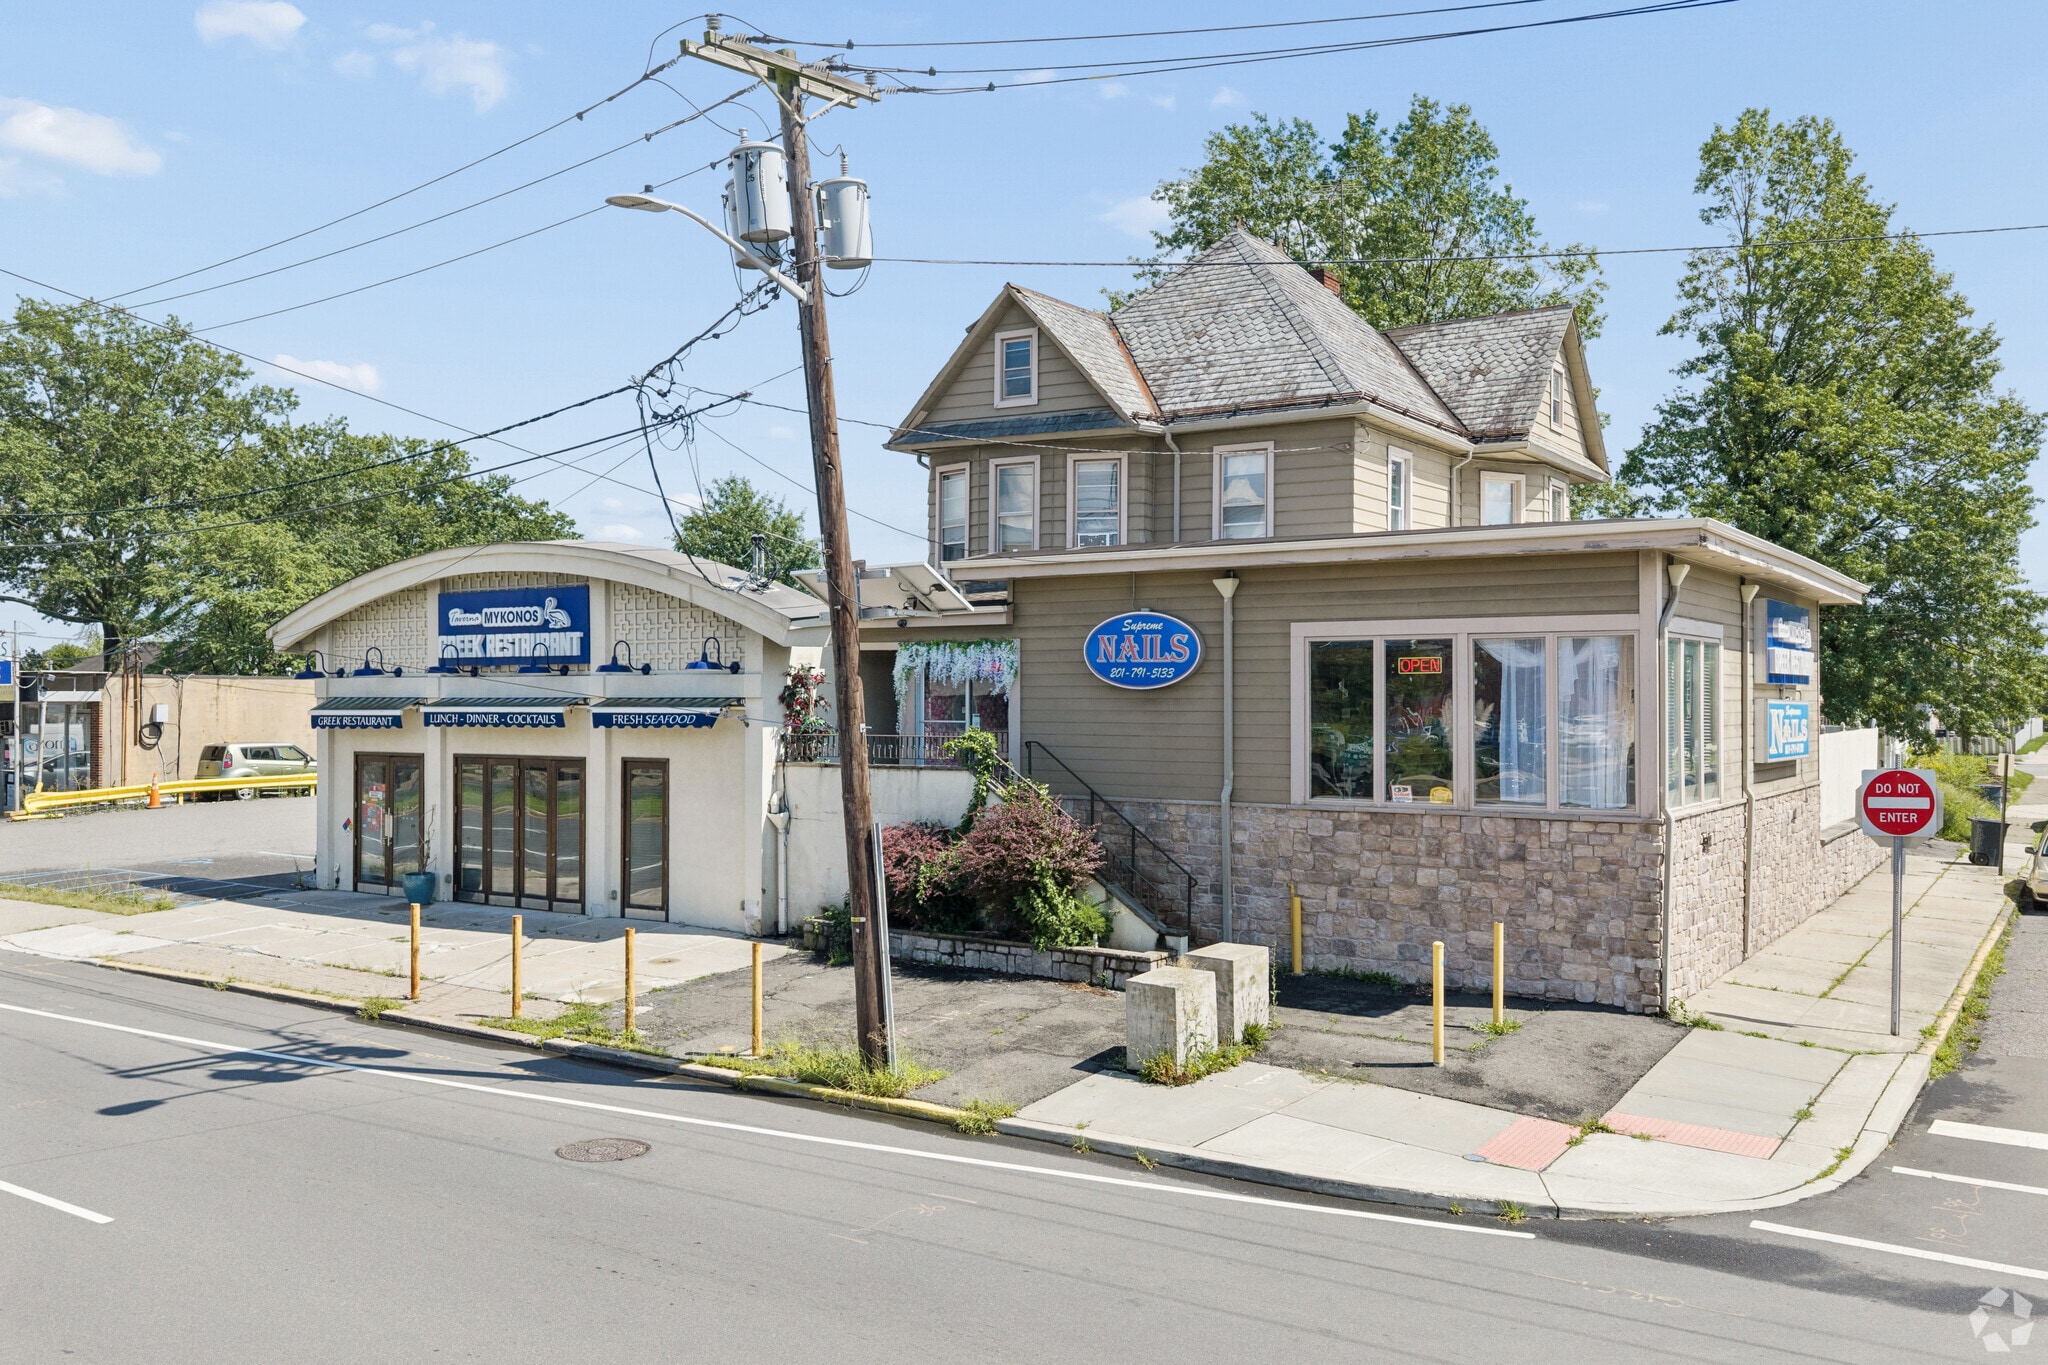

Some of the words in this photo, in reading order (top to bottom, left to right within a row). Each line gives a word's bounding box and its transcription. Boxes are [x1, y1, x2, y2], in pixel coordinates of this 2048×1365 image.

[450, 610, 480, 623] Taverna
[484, 609, 539, 624] MYKONOS
[1122, 619, 1163, 633] Supreme
[486, 632, 583, 657] RESTAURANT
[1096, 633, 1190, 663] NAILS
[1400, 658, 1440, 672] OPEN
[1110, 667, 1175, 678] 201-791-5133
[317, 716, 341, 726] GREEK
[342, 716, 393, 726] RESTAURANT
[429, 714, 458, 724] LUNCH
[466, 714, 500, 724] DINNER
[506, 714, 556, 725] COCKTAILS
[612, 714, 643, 725] FRESH
[644, 714, 697, 725] SEAFOOD
[1769, 709, 1808, 754] NAILS
[1875, 783, 1891, 793] DO
[1898, 783, 1920, 793] NOT
[1879, 812, 1918, 823] ENTER
